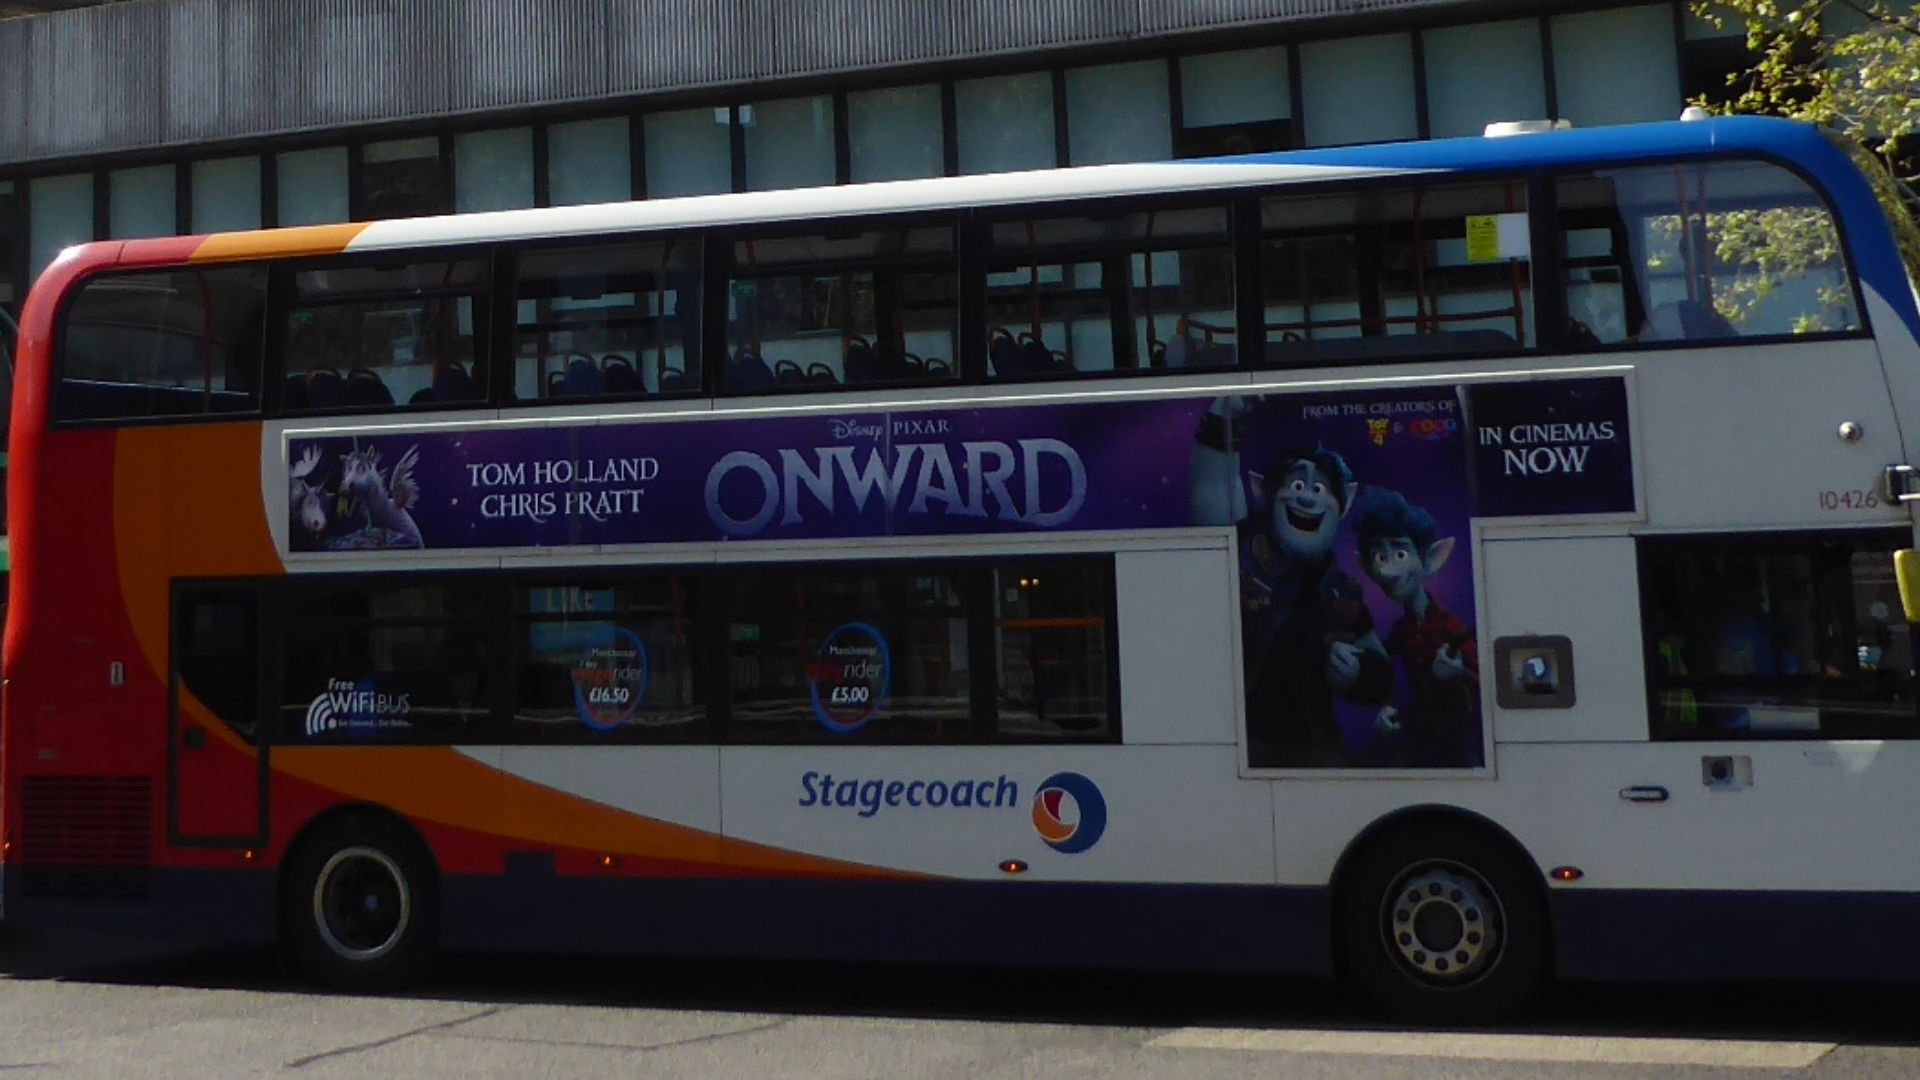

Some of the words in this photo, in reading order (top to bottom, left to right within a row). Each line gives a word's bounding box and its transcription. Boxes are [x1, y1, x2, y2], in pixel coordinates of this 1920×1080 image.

[1303, 404, 1338, 419] FROM
[1342, 403, 1367, 416] THE
[1369, 401, 1435, 416] CREATORS
[1438, 400, 1457, 413] OF
[829, 418, 883, 442] Disney
[893, 419, 950, 436] PIXAR
[1366, 418, 1389, 430] TOY
[1393, 421, 1404, 434] &
[1479, 426, 1502, 445] IN
[1509, 421, 1615, 444] CINEMAS
[466, 462, 526, 487] TOM
[533, 457, 660, 485] HOLLAND
[1502, 445, 1591, 475] NOW
[704, 438, 1088, 535] ONWARD
[480, 491, 557, 523] CHRIS
[564, 488, 645, 522] PRATT
[1818, 489, 1878, 510] 10426
[328, 677, 355, 691] Free
[589, 686, 630, 703] £16.50
[831, 686, 870, 703] £5.00
[329, 690, 375, 713] WiFi
[377, 694, 410, 714] BUS
[798, 771, 1018, 818] Stagecoach
